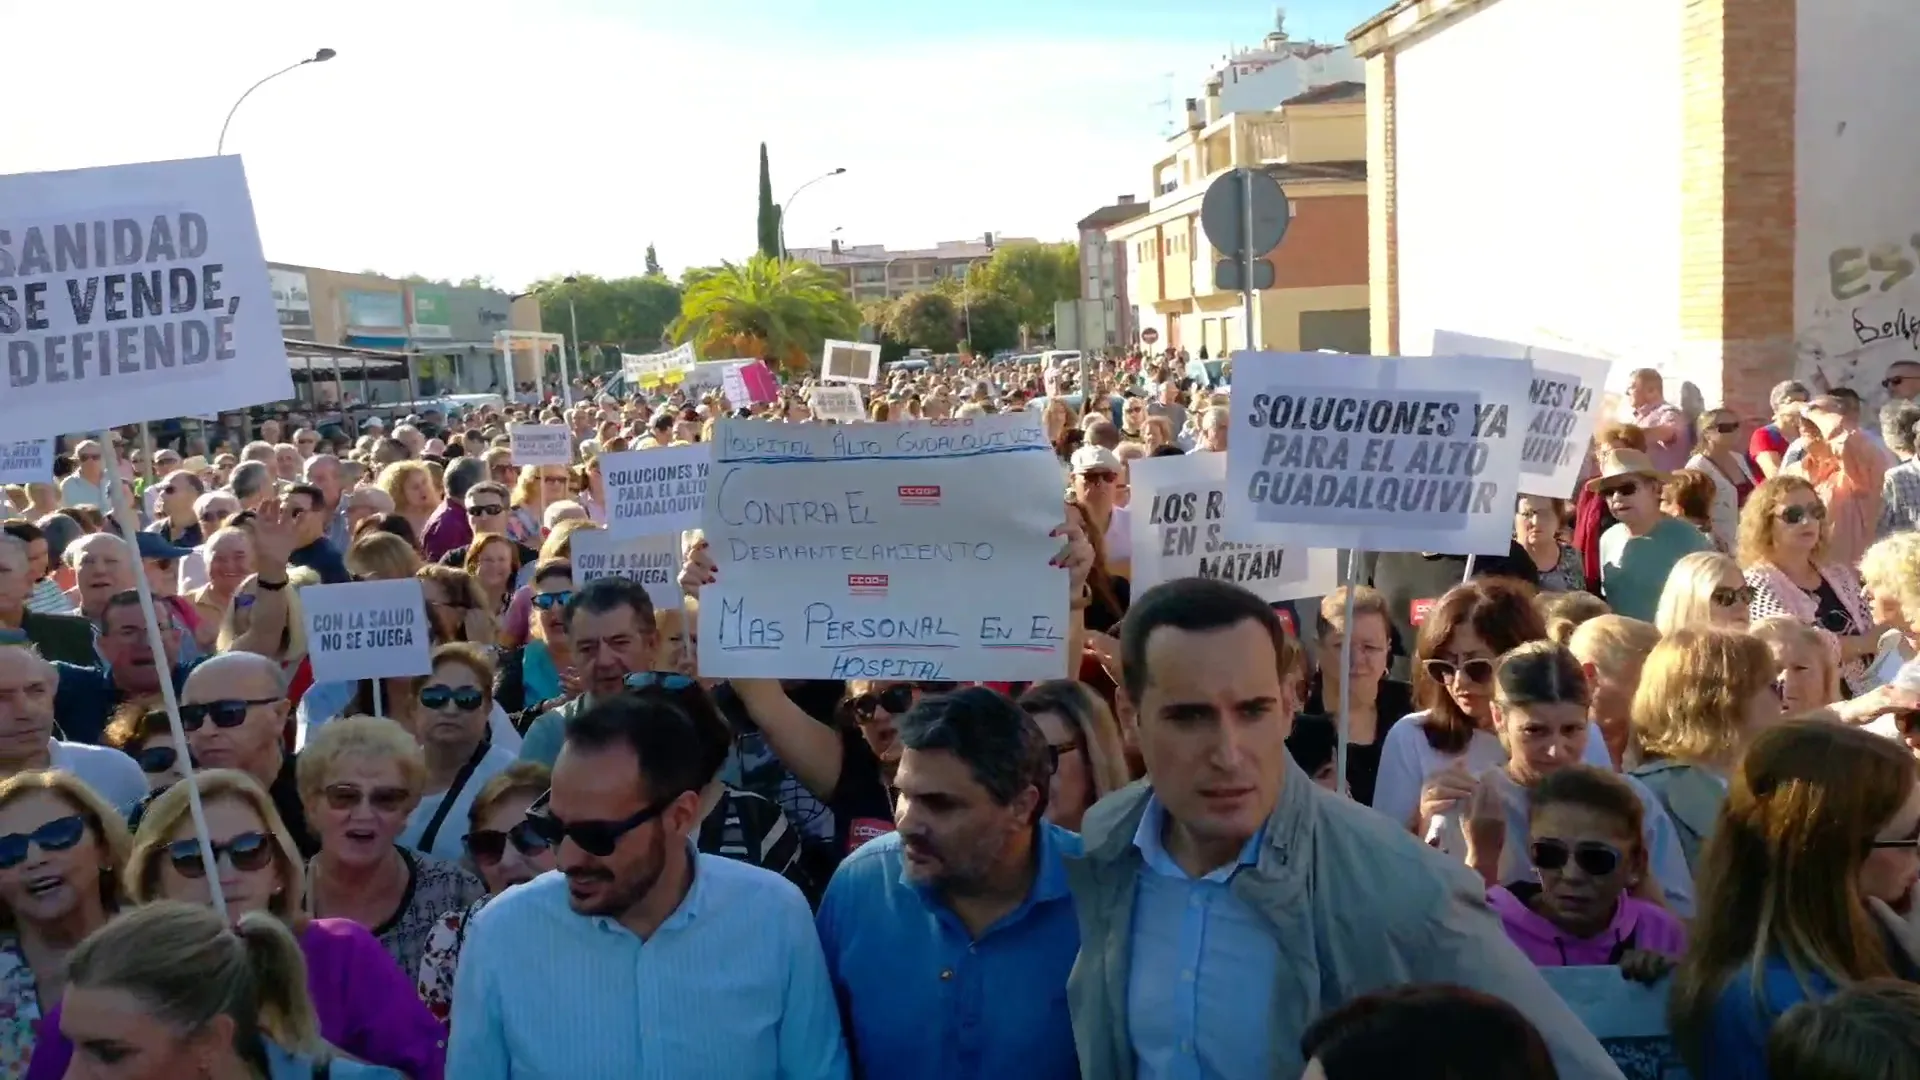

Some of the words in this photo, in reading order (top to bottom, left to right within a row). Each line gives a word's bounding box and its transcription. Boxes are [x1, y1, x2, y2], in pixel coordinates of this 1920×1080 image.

[0, 282, 49, 334] SE
[66, 264, 240, 326] VENDE,
[8, 315, 236, 388] DEFIENDE
[1570, 386, 1593, 412] YA
[1248, 393, 1460, 437] SOLUCIONES
[1470, 403, 1509, 438] YA
[1527, 409, 1578, 438] ALTO
[833, 430, 882, 456] ALTO
[1262, 433, 1349, 471] PARA
[1361, 438, 1395, 473] EL
[1404, 441, 1490, 477] ALTO
[608, 464, 692, 486] SOLUCIONES
[618, 486, 653, 501] PARA
[659, 483, 670, 498] EL
[676, 480, 707, 496] ALTO
[717, 467, 838, 526] CONTRA
[845, 490, 878, 524] EL
[1247, 470, 1498, 515] GUADALQUIVIR
[1150, 491, 1197, 525] LOS
[728, 537, 994, 562] DESMANTELAMIENTO
[1162, 525, 1197, 557] EN
[578, 554, 606, 569] CON
[611, 554, 626, 569] LA
[630, 553, 673, 568] SALUD
[313, 613, 343, 633] CON
[348, 611, 364, 630] LA
[369, 608, 414, 629] SALUD
[719, 597, 785, 646] MAS
[804, 602, 960, 645] PERSONAL
[980, 616, 1013, 639] EN
[1030, 615, 1064, 640] EL
[321, 633, 342, 652] NO
[346, 632, 362, 650] SE
[366, 628, 413, 648] JUEGA
[831, 655, 951, 680] HOSPITAL
